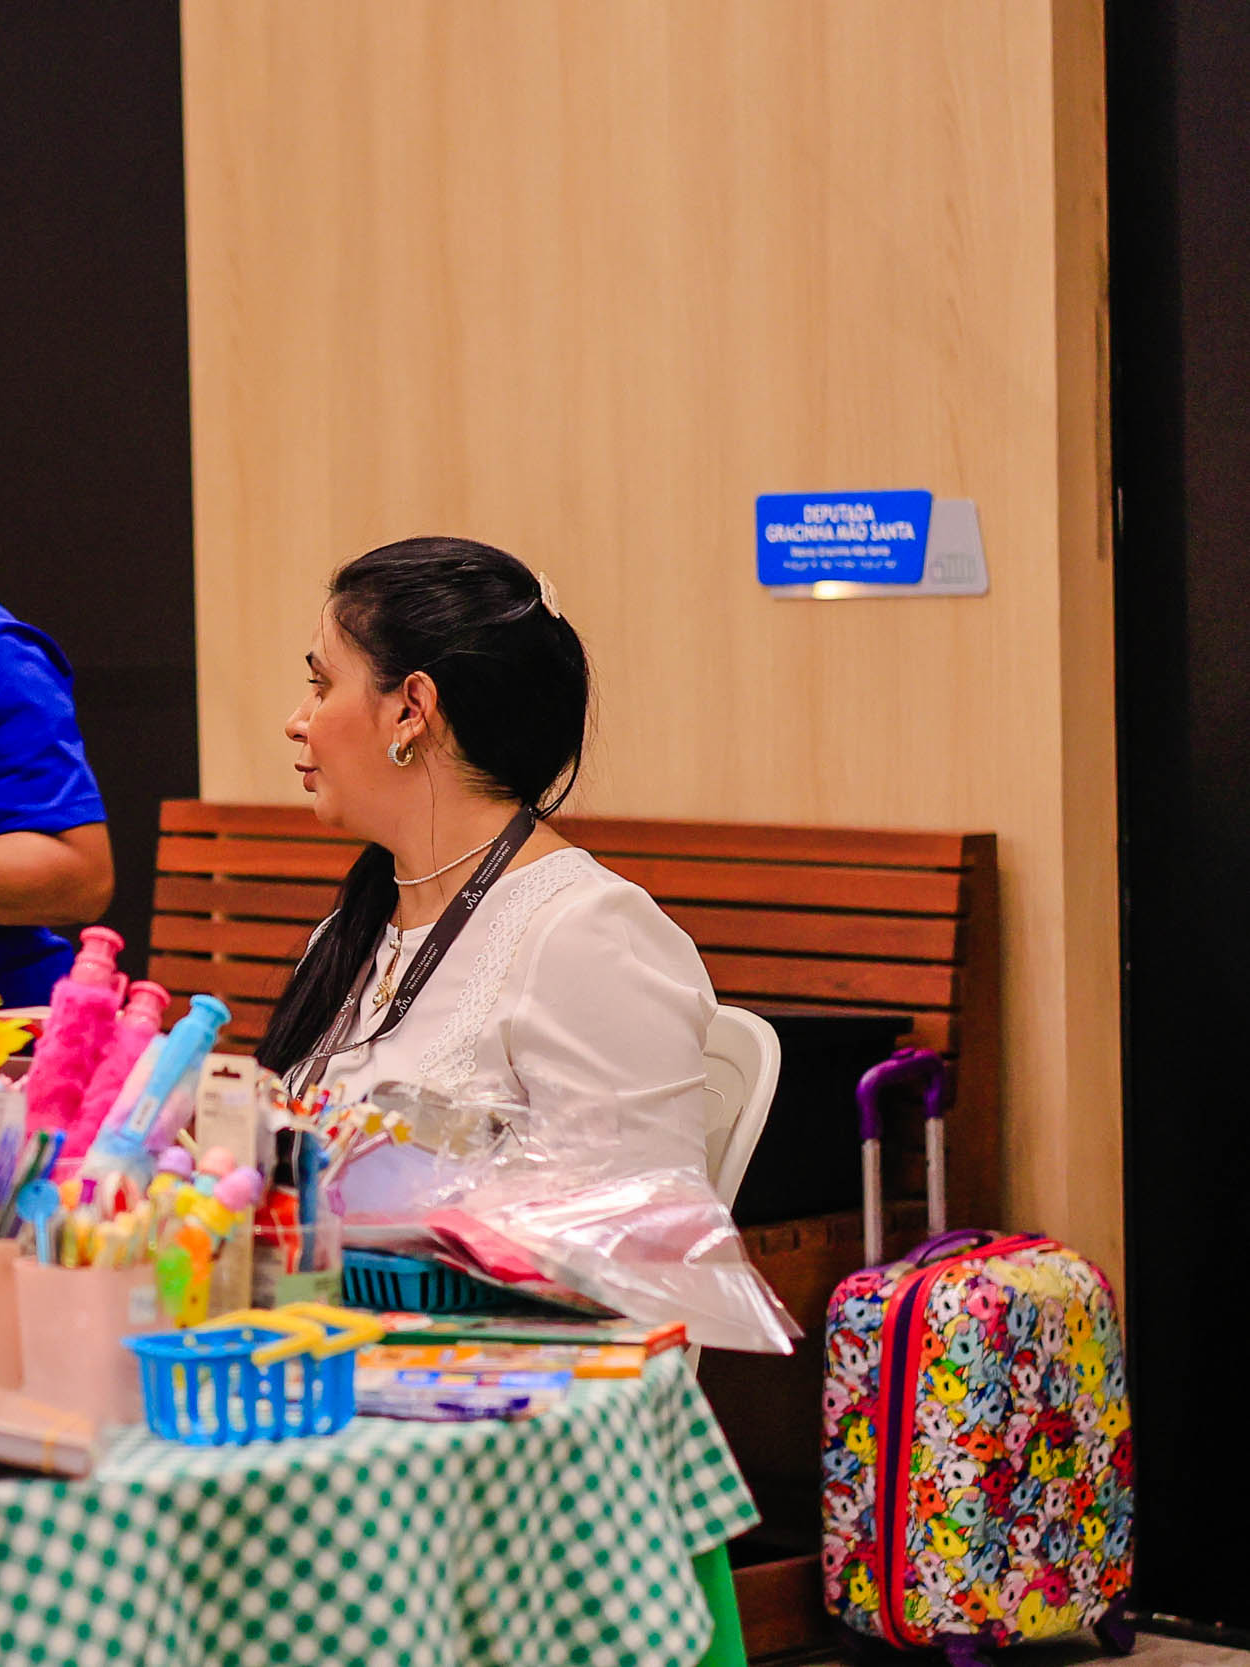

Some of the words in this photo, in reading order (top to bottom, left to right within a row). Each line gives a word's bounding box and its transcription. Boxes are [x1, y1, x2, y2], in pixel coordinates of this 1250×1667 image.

[803, 504, 876, 523] DEPUTADA
[765, 523, 835, 543] GRACINHA
[836, 522, 869, 542] MÃO
[870, 521, 916, 541] SANTA
